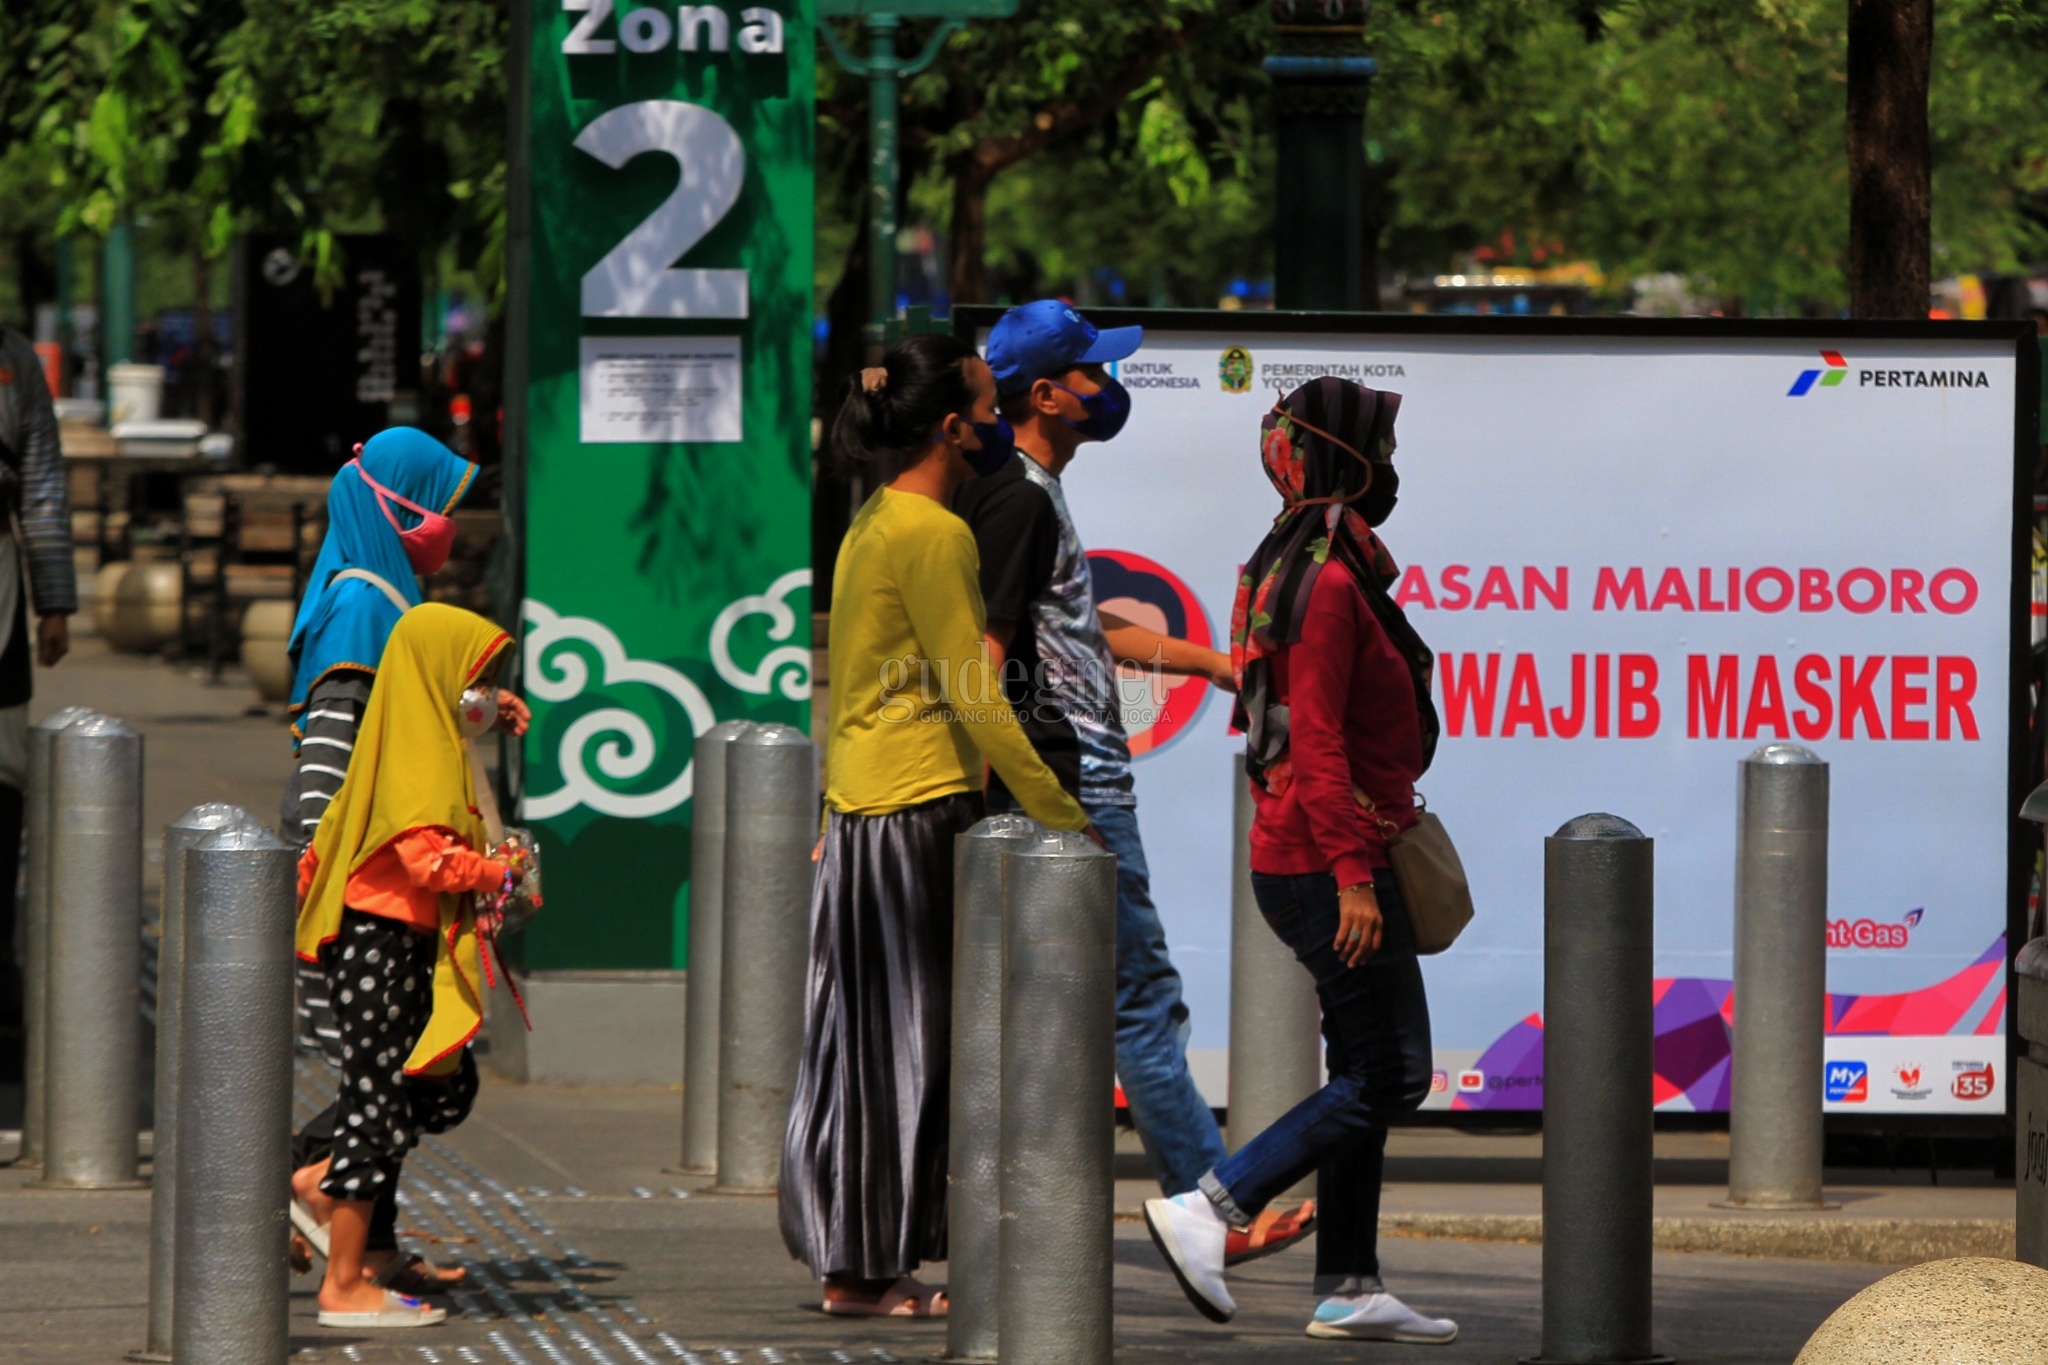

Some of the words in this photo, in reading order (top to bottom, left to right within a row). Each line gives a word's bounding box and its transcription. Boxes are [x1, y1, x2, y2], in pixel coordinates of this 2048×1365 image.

[562, 0, 784, 54] Zona
[573, 100, 749, 318] 2
[1123, 363, 1173, 375] UNTUK
[1262, 364, 1359, 376] PEMERINTAH
[1363, 364, 1405, 377] KOTA
[1859, 370, 1990, 388] PERTAMINA
[1123, 377, 1200, 389] INDONESIA
[1594, 566, 1979, 614] MALIOBORO
[1438, 652, 1661, 739] WAJIB
[1687, 654, 1980, 742] MASKER
[1854, 923, 1905, 945] Gas
[1829, 1066, 1864, 1089] My
[1952, 1075, 1988, 1097] 135
